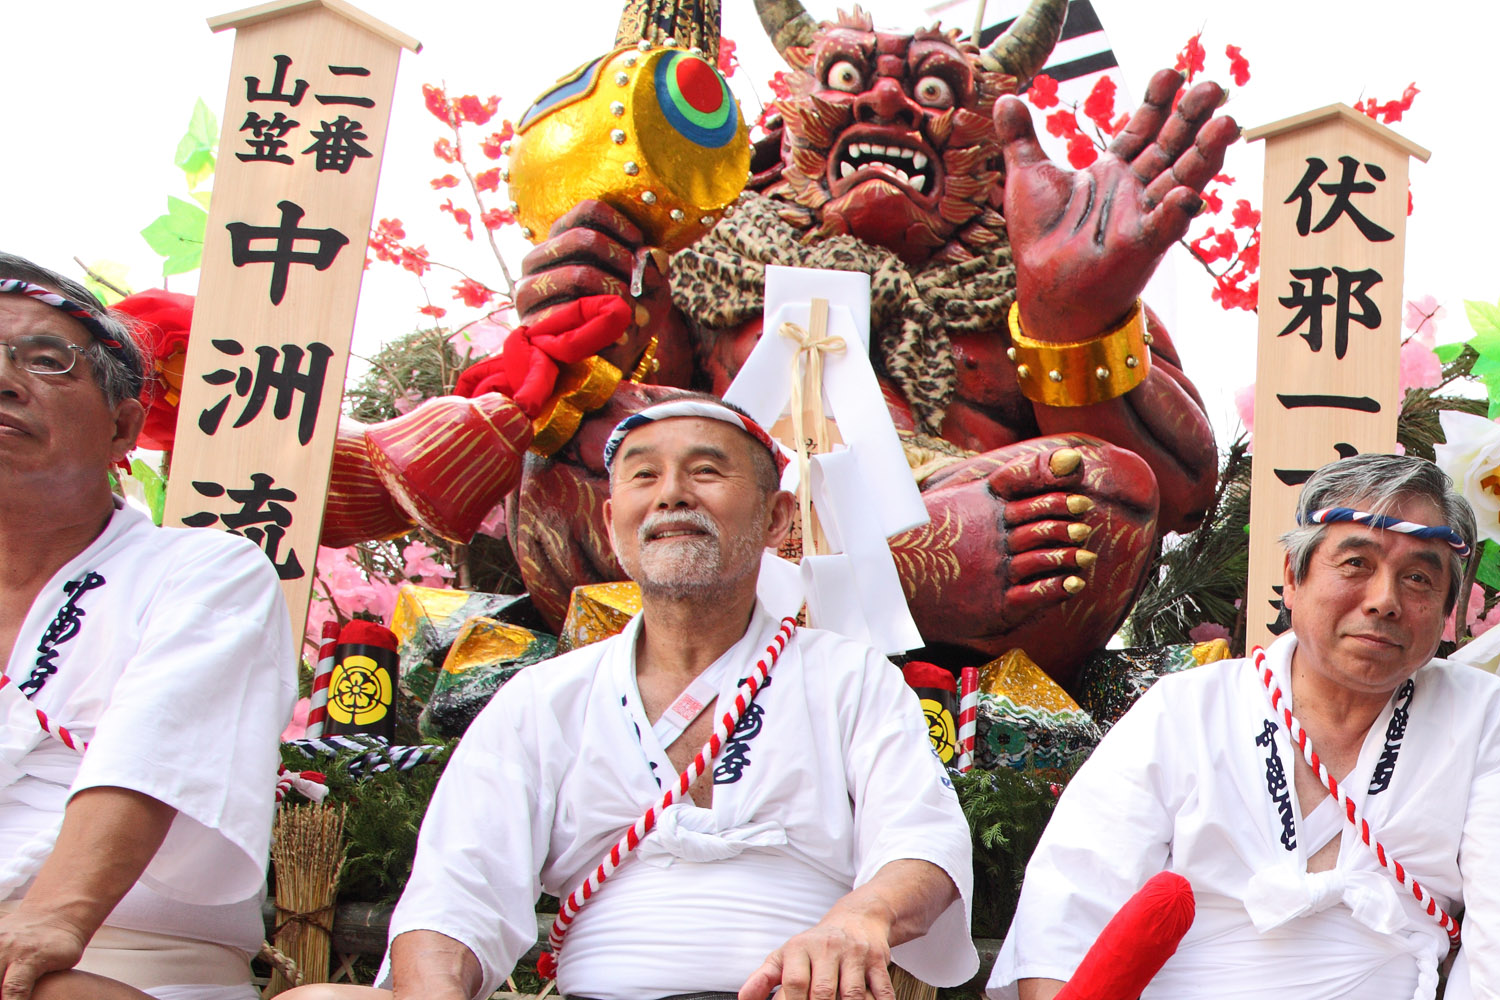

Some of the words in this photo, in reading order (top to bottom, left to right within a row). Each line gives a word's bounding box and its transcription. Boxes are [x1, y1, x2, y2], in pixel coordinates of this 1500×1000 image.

[235, 55, 309, 166] 山笠
[302, 65, 375, 174] 二番
[181, 200, 349, 581] 中洲流
